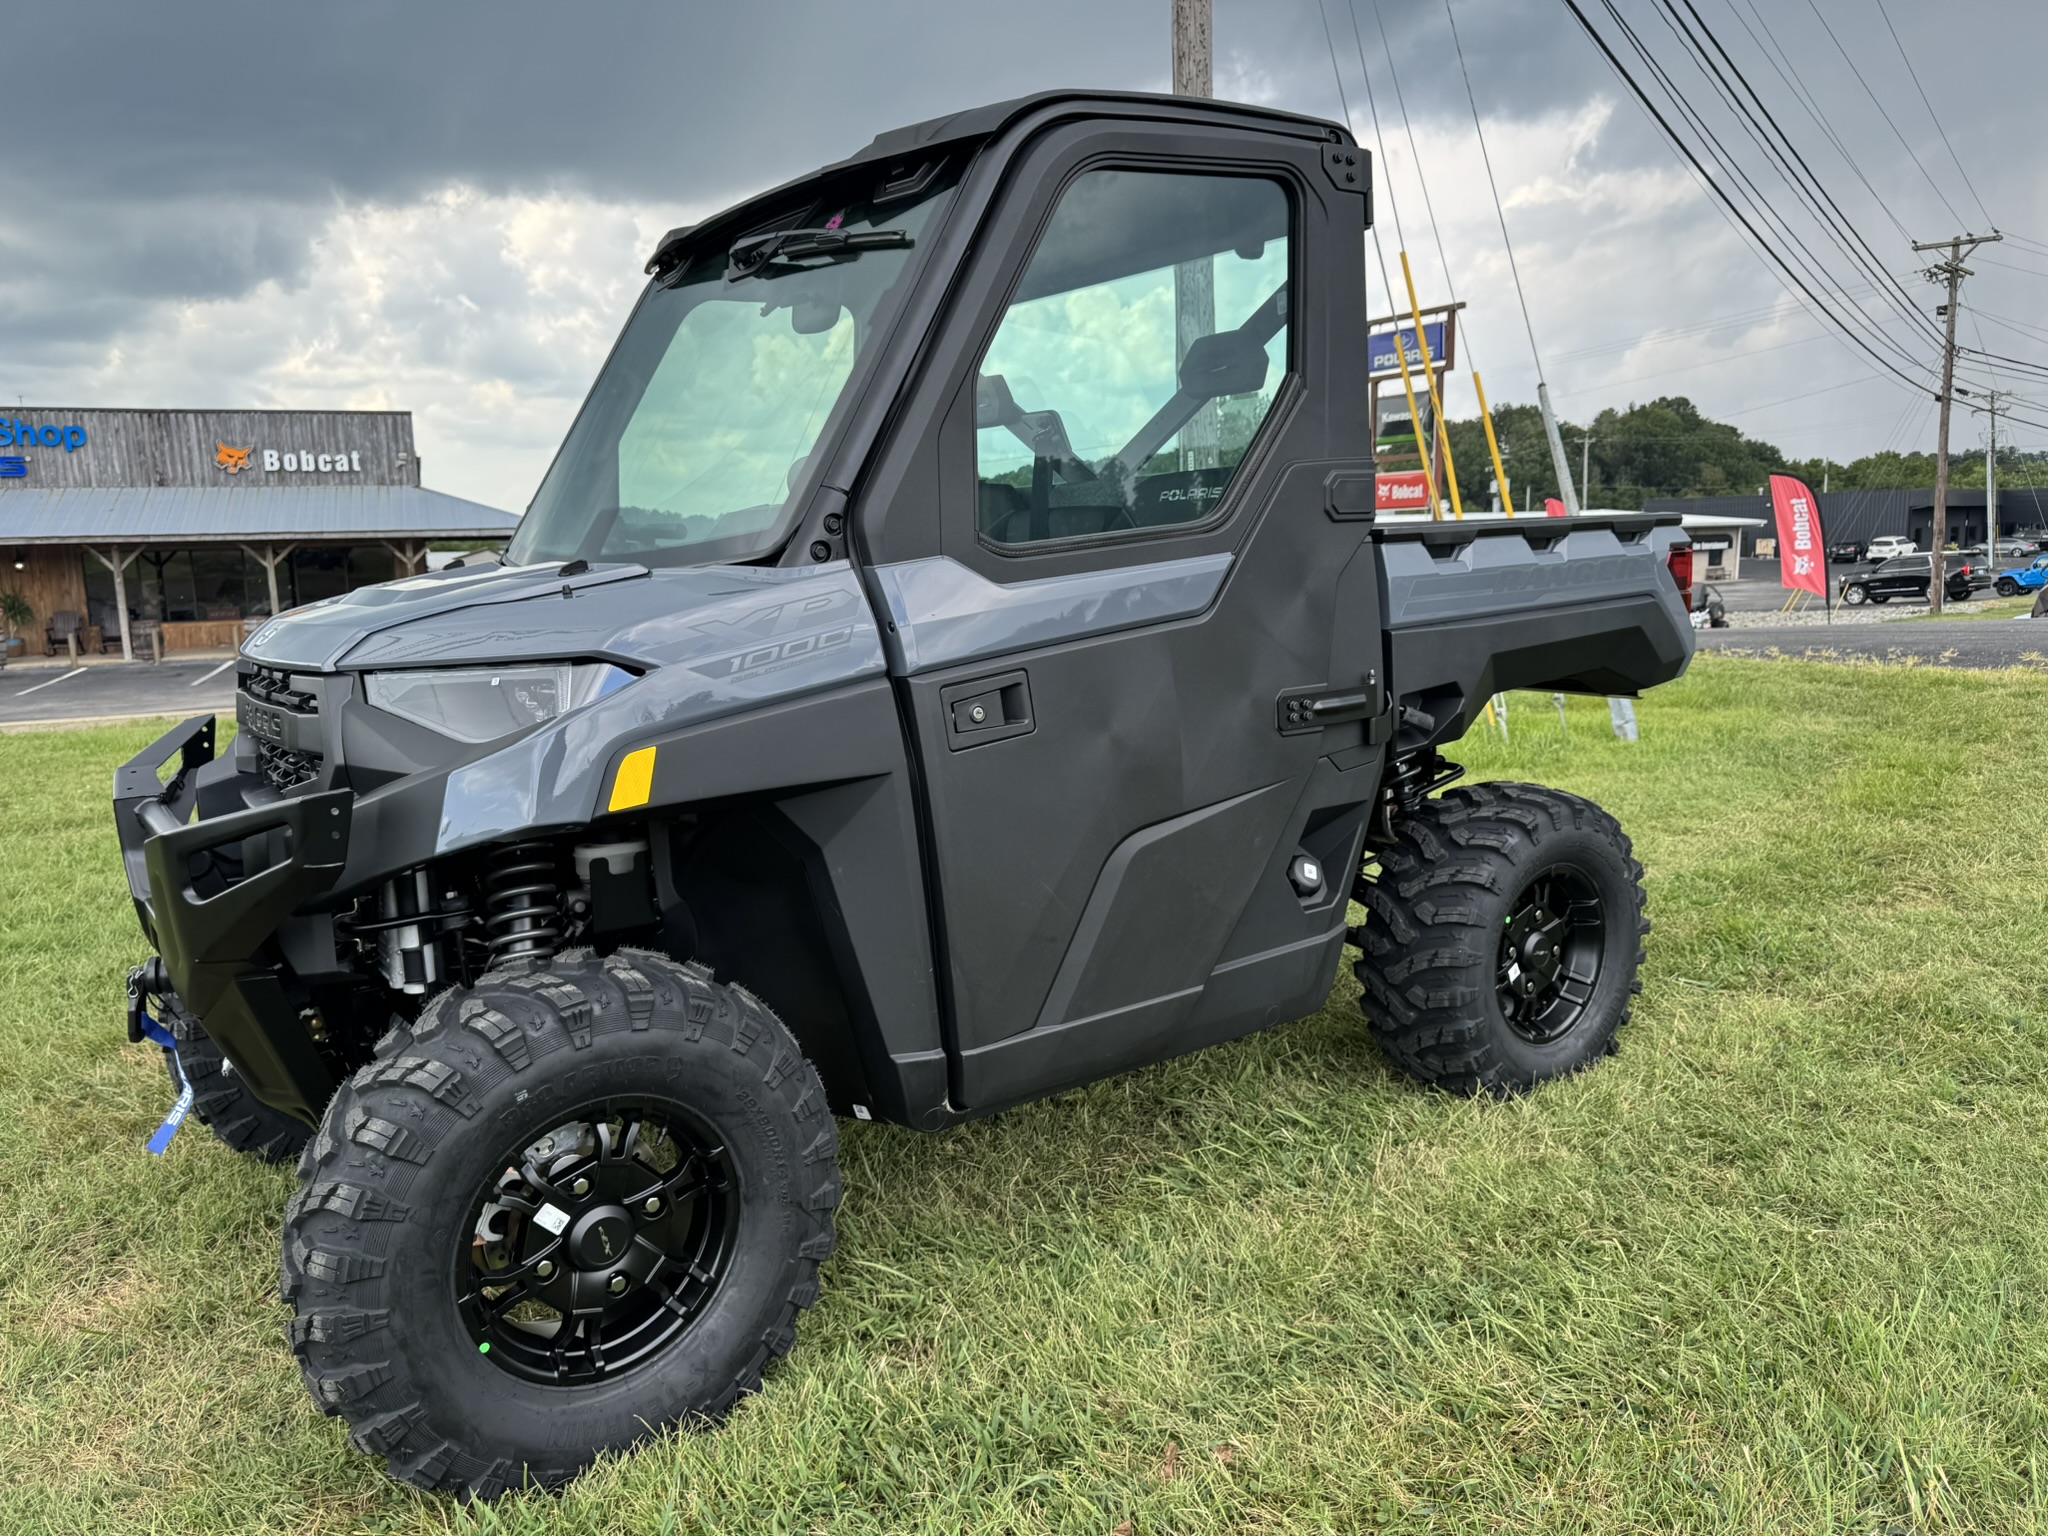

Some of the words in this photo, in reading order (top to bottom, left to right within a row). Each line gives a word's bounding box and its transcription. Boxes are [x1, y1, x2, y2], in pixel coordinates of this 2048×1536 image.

[1373, 346, 1435, 368] POLARS
[0, 418, 87, 453] Shop
[263, 449, 361, 472] Bobcat
[1159, 486, 1223, 502] POLARIS
[1391, 483, 1424, 499] Bobcat
[1790, 498, 1812, 550] Bobcat
[1492, 558, 1641, 593] RANGER
[730, 626, 851, 673] 1000
